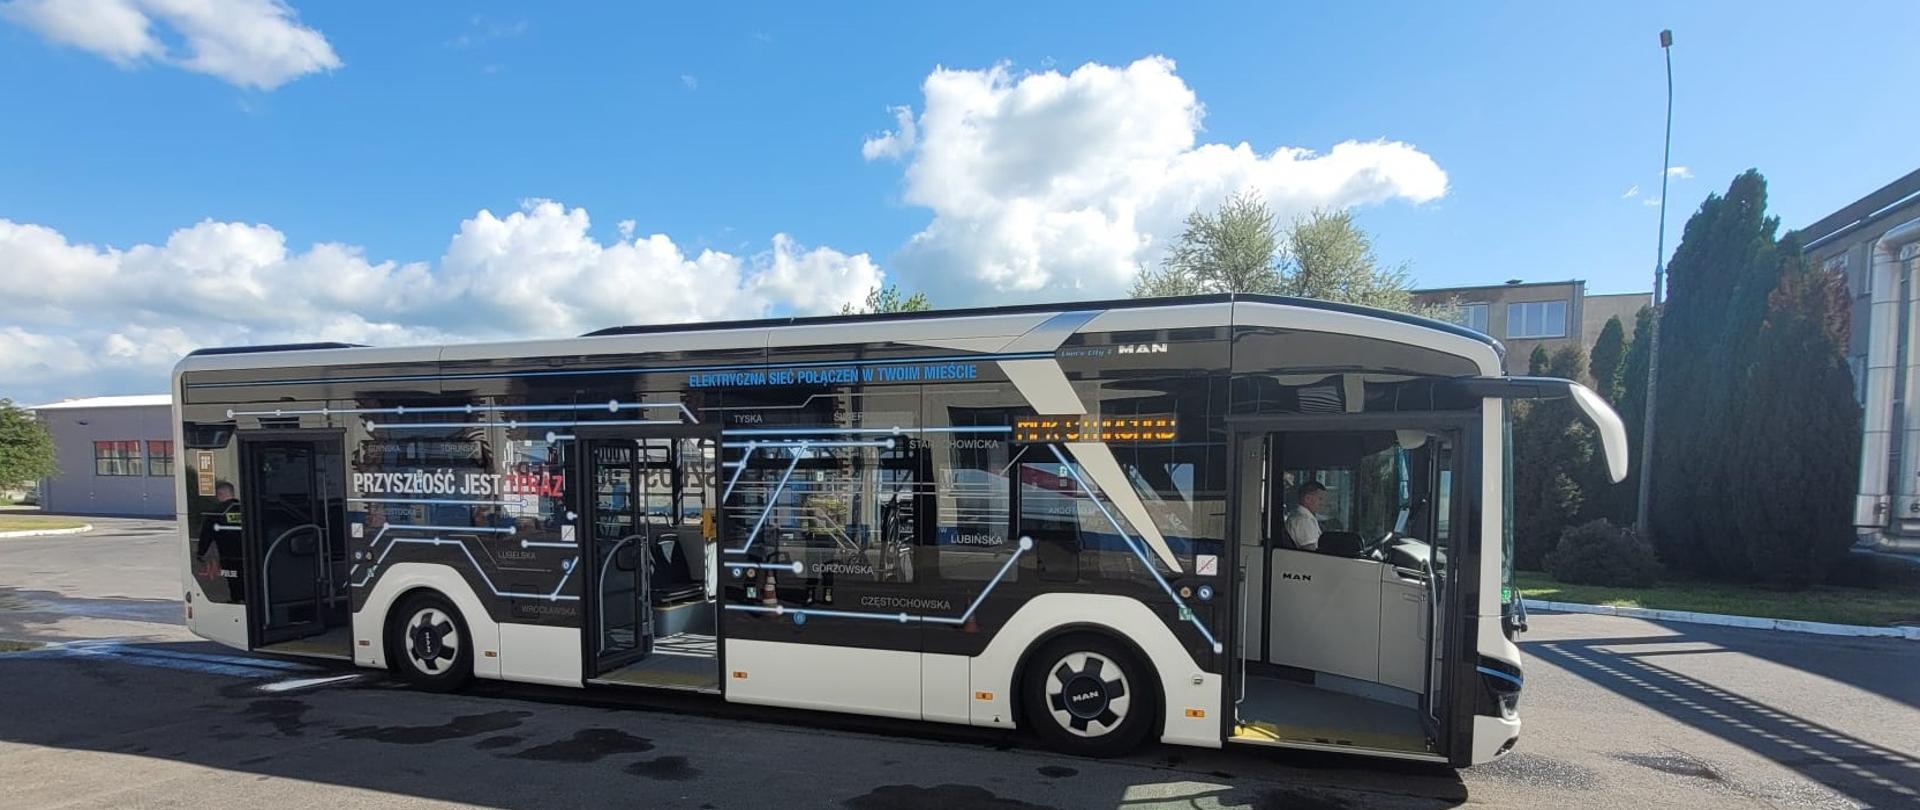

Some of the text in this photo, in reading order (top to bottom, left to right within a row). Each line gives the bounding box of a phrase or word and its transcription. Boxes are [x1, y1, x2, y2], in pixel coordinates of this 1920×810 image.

[1118, 343, 1168, 355] MAN
[689, 363, 977, 388] ELEKTRYCZNA SIEĆ POŁĄCZEŃ W TWOIM MIEŚCIE
[733, 414, 763, 424] TYSKA
[353, 469, 456, 494] PRZYSZŁOŚĆ
[460, 473, 502, 495] JEST
[950, 534, 1003, 545] LUBIŃSKA
[812, 563, 874, 575] GORZOWSKA
[1282, 572, 1312, 581] MAN
[861, 595, 951, 610] CZĘSTOCHOWSKA
[1072, 690, 1099, 702] MAN
